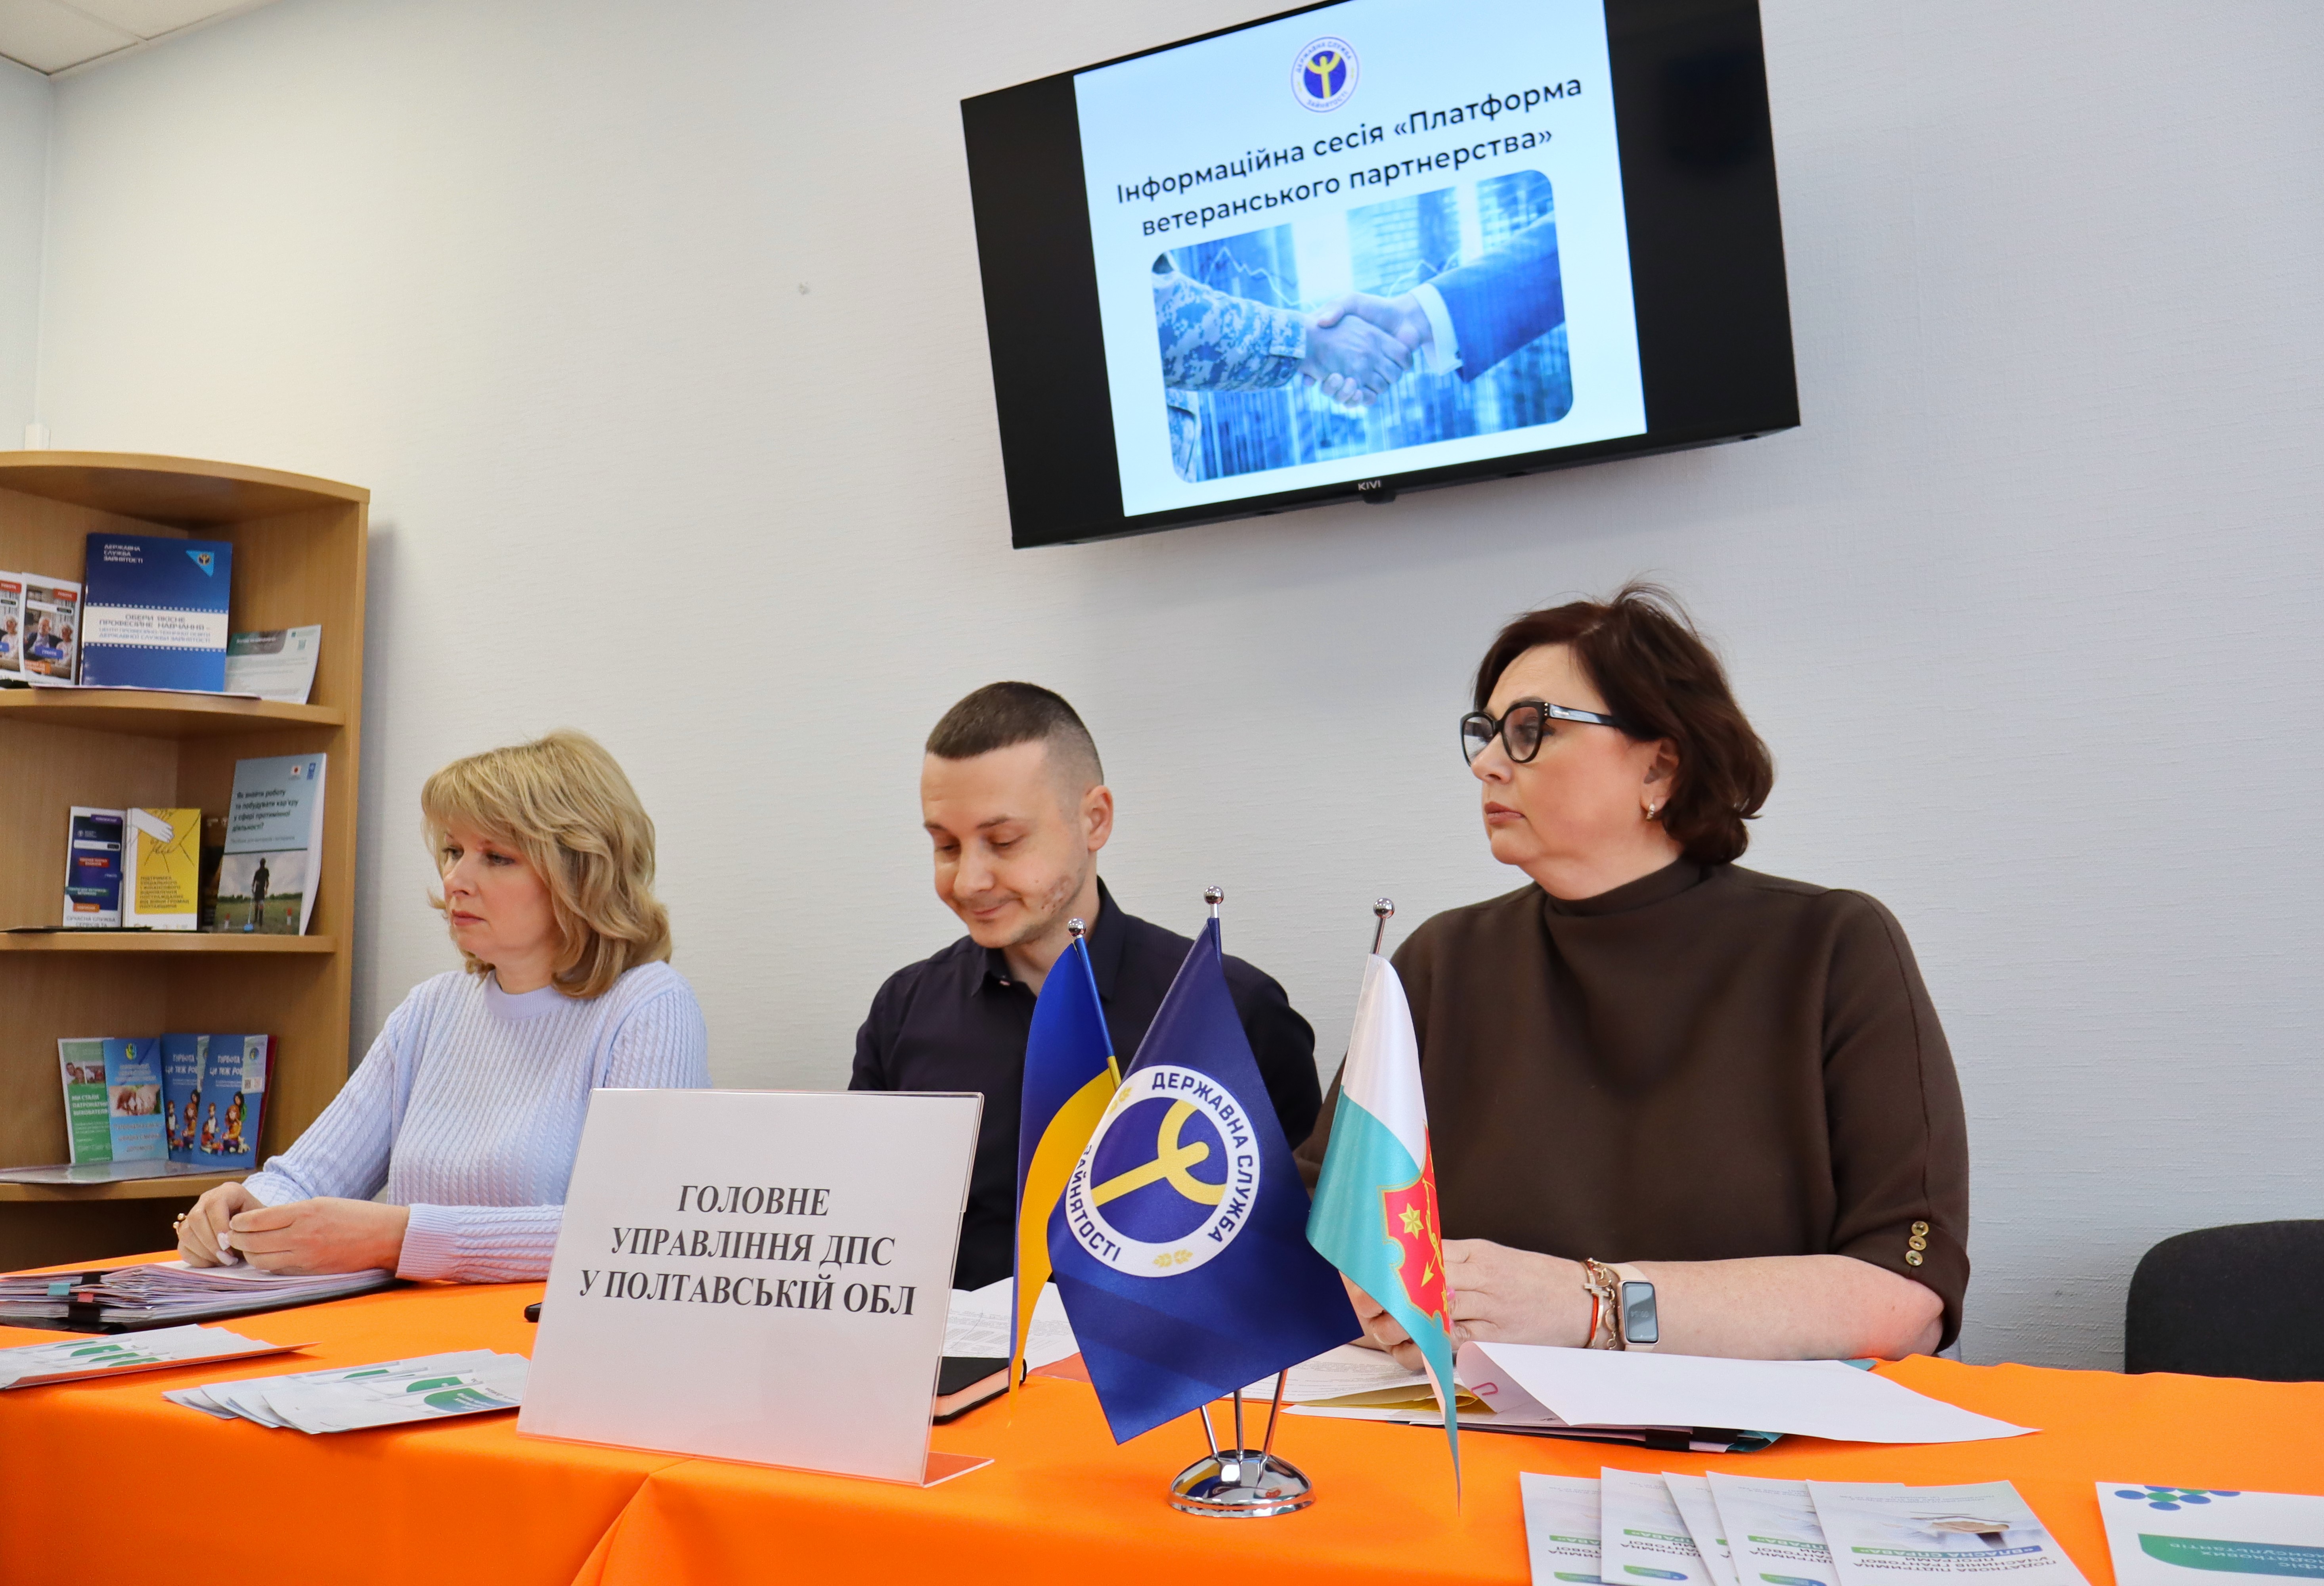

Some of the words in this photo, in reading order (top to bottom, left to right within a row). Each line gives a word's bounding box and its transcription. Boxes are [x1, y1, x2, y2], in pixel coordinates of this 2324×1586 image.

[1327, 41, 1351, 59] СЛУЖБА
[1117, 146, 1304, 203] Інформаційна
[1314, 123, 1383, 156] сесія
[1394, 79, 1582, 135] «Платформа
[1142, 177, 1340, 236] ветеранського
[1350, 130, 1551, 188] партнерства»
[1358, 480, 1381, 491] KIVI
[1151, 1072, 1249, 1149] ДЕРЖАВНА
[1208, 1155, 1253, 1243] СЛУЖБА
[676, 1185, 830, 1216] ГОЛОВНЕ
[611, 1227, 815, 1262] УПРАВЛІННЯ
[819, 1235, 896, 1270] ДПС
[580, 1270, 601, 1297] У
[604, 1270, 836, 1310] ПОЛТАВСЬКІЙ
[844, 1283, 917, 1315] ОБЛ
[1860, 1548, 1942, 1557] СПРАВА»
[1947, 1547, 2034, 1557] «ВЛАСНА
[1853, 1563, 1951, 1572] ПІДТРИМКА
[1957, 1560, 2057, 1572] ПОДАТКОВА
